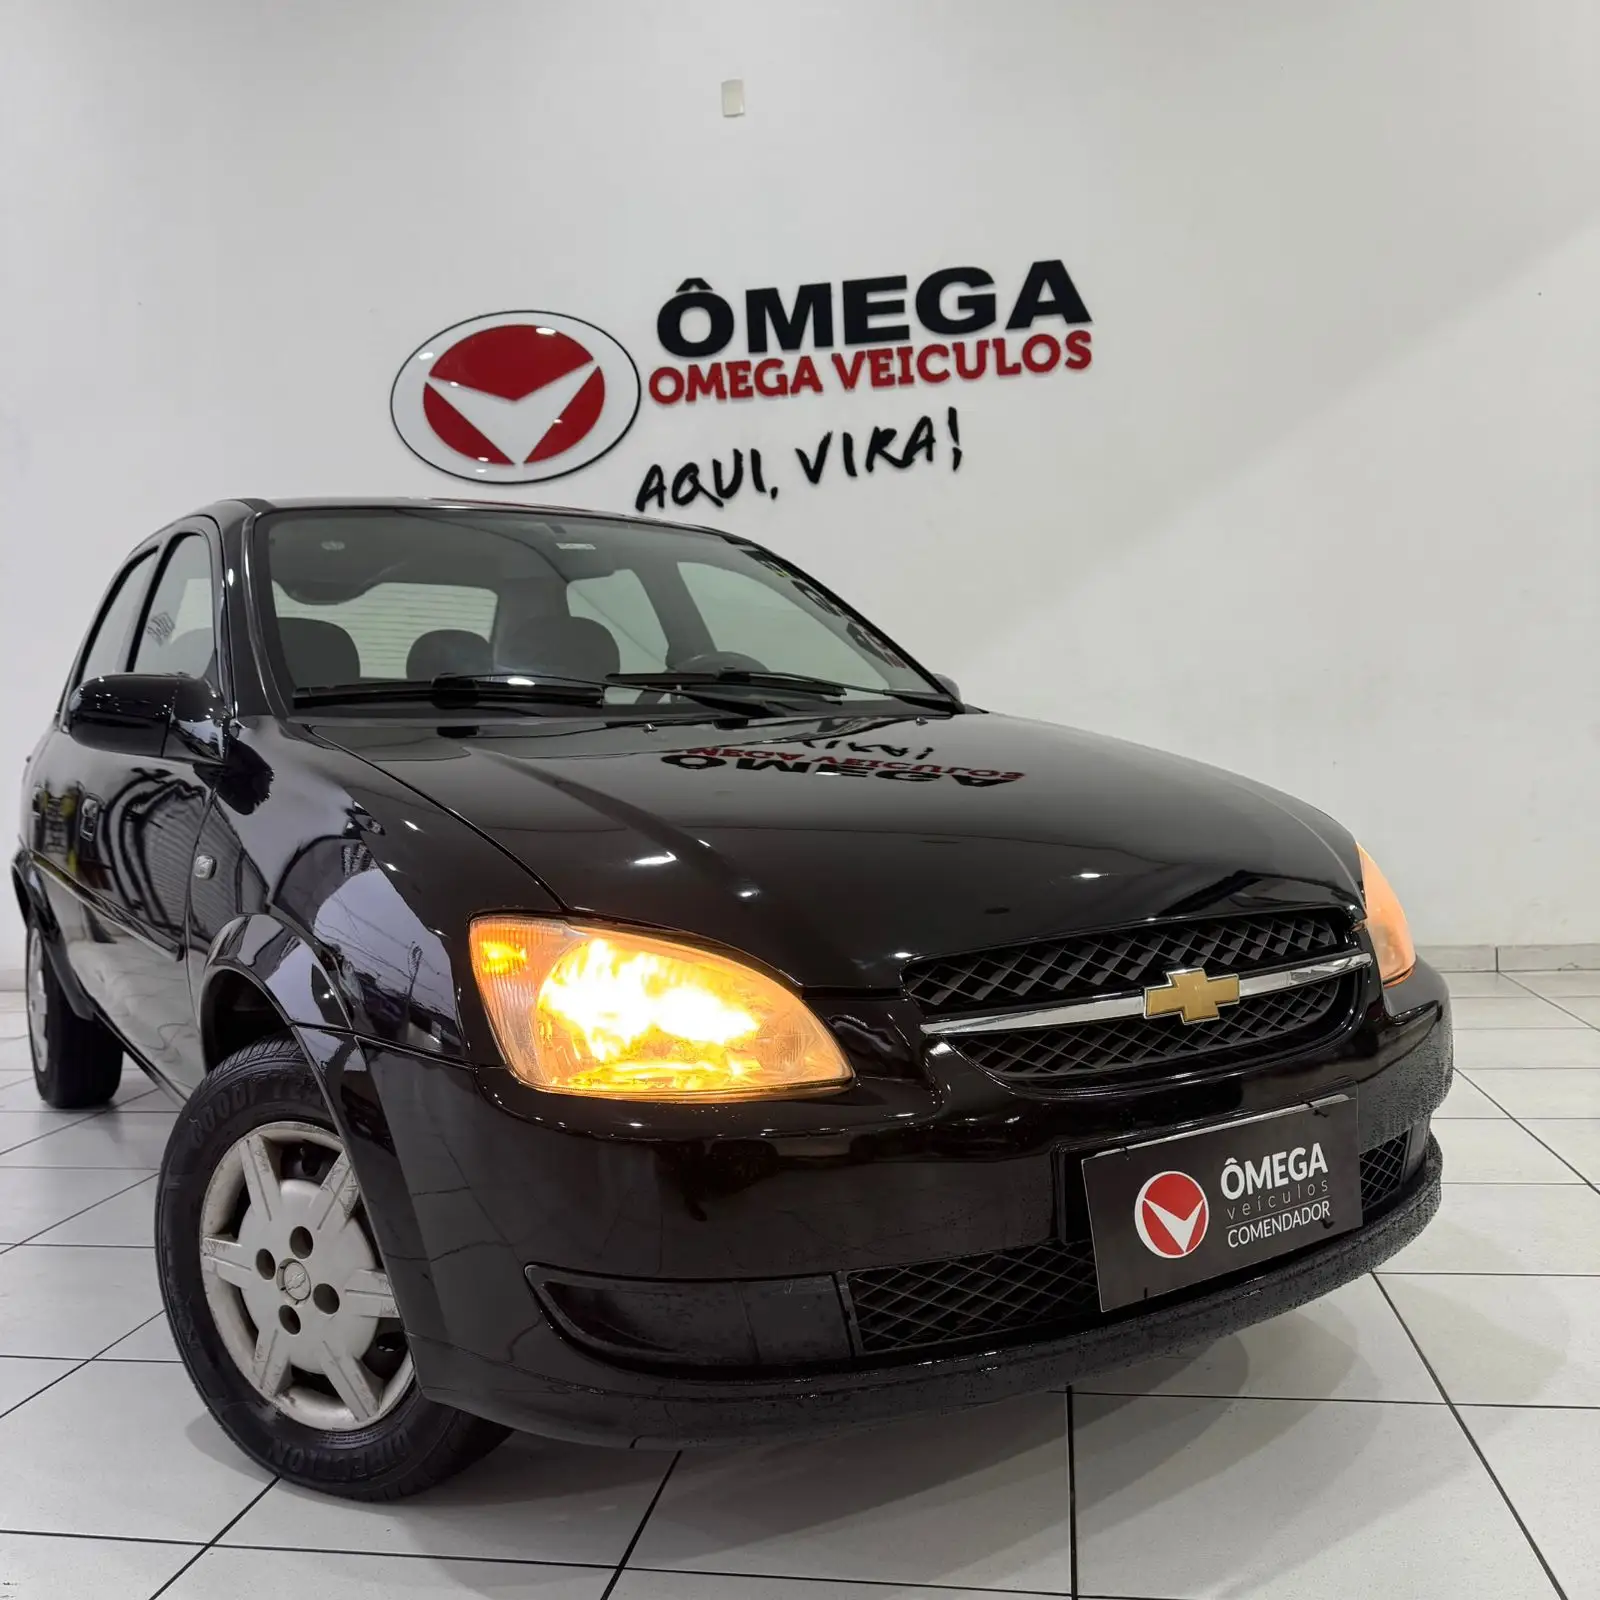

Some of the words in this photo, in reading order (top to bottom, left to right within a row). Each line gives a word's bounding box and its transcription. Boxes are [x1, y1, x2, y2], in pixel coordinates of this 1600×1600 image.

[656, 259, 1093, 359] ÔMEGA
[648, 356, 824, 405] OMEGA
[832, 331, 1092, 390] VEICULOS
[634, 448, 779, 513] AQUI,
[795, 406, 963, 485] VIRA!
[1220, 1142, 1329, 1200] ÔMEGA
[1227, 1200, 1331, 1248] COMENDADOR
